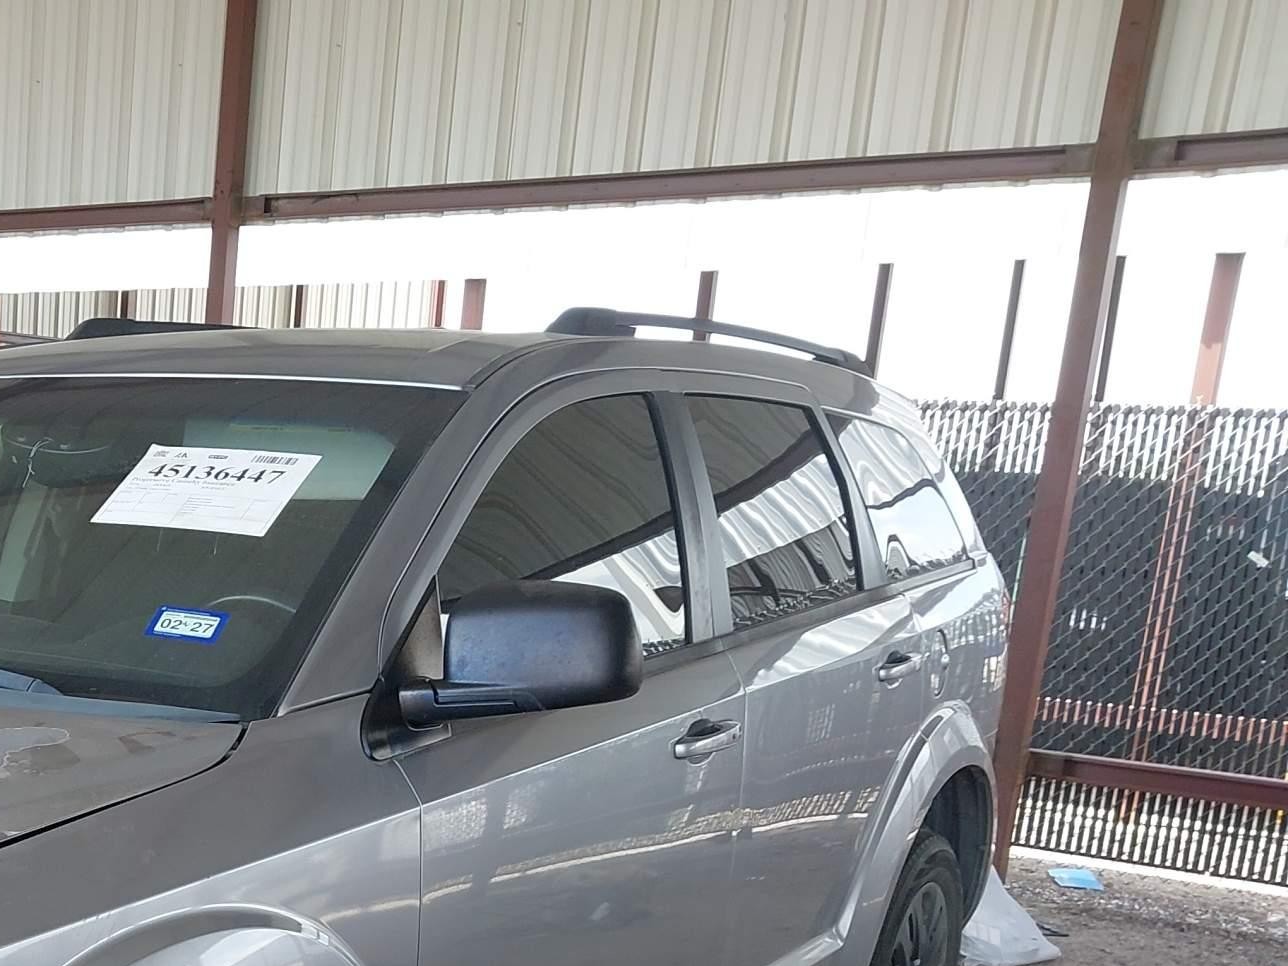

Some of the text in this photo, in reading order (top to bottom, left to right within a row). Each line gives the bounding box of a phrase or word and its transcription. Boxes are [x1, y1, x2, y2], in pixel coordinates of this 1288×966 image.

[148, 463, 287, 484] 45136447
[160, 618, 214, 633] 02 27
